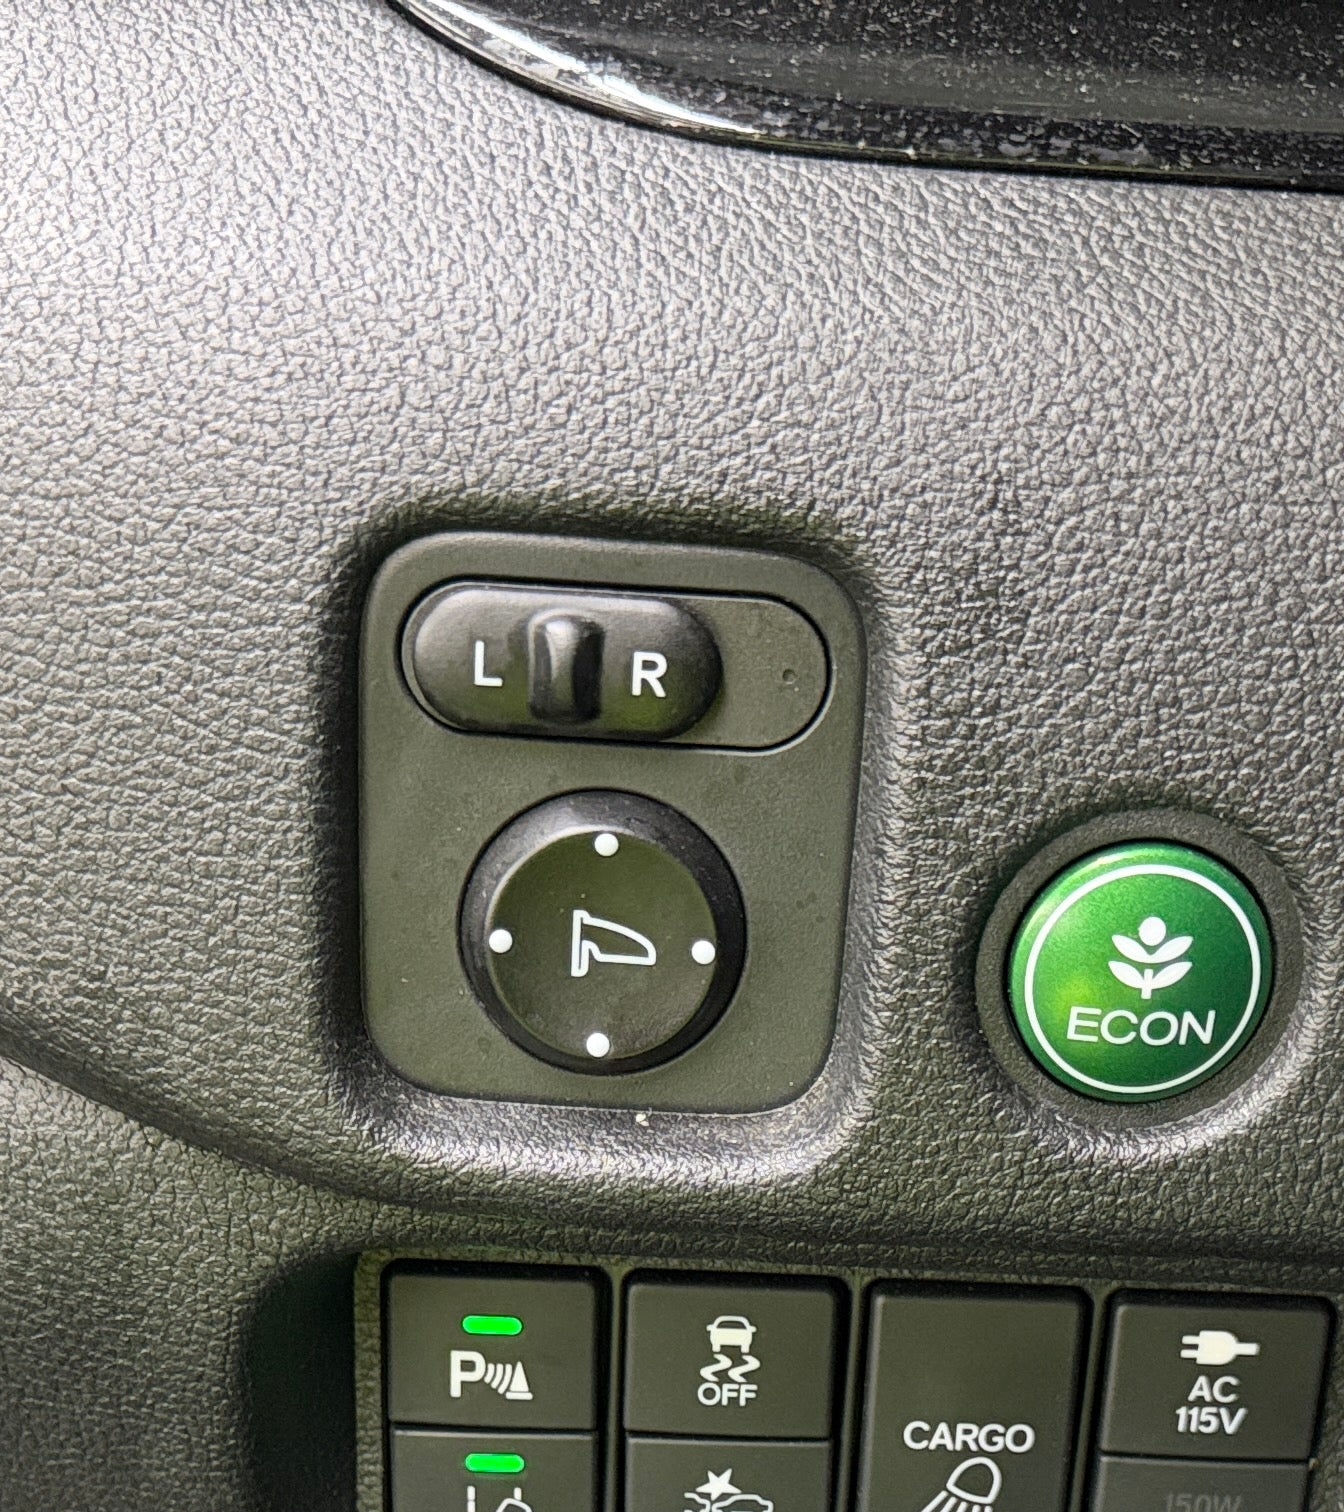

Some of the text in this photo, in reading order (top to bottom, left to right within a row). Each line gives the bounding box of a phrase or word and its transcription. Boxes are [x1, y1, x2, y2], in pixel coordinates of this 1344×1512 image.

[473, 639, 503, 688] L
[630, 649, 667, 699] R
[1065, 1005, 1216, 1047] ECON
[449, 1349, 487, 1398] P
[1186, 1375, 1241, 1404] AC
[696, 1382, 758, 1407] OFF
[902, 1420, 1036, 1454] CARGO
[1175, 1406, 1248, 1436] 115V
